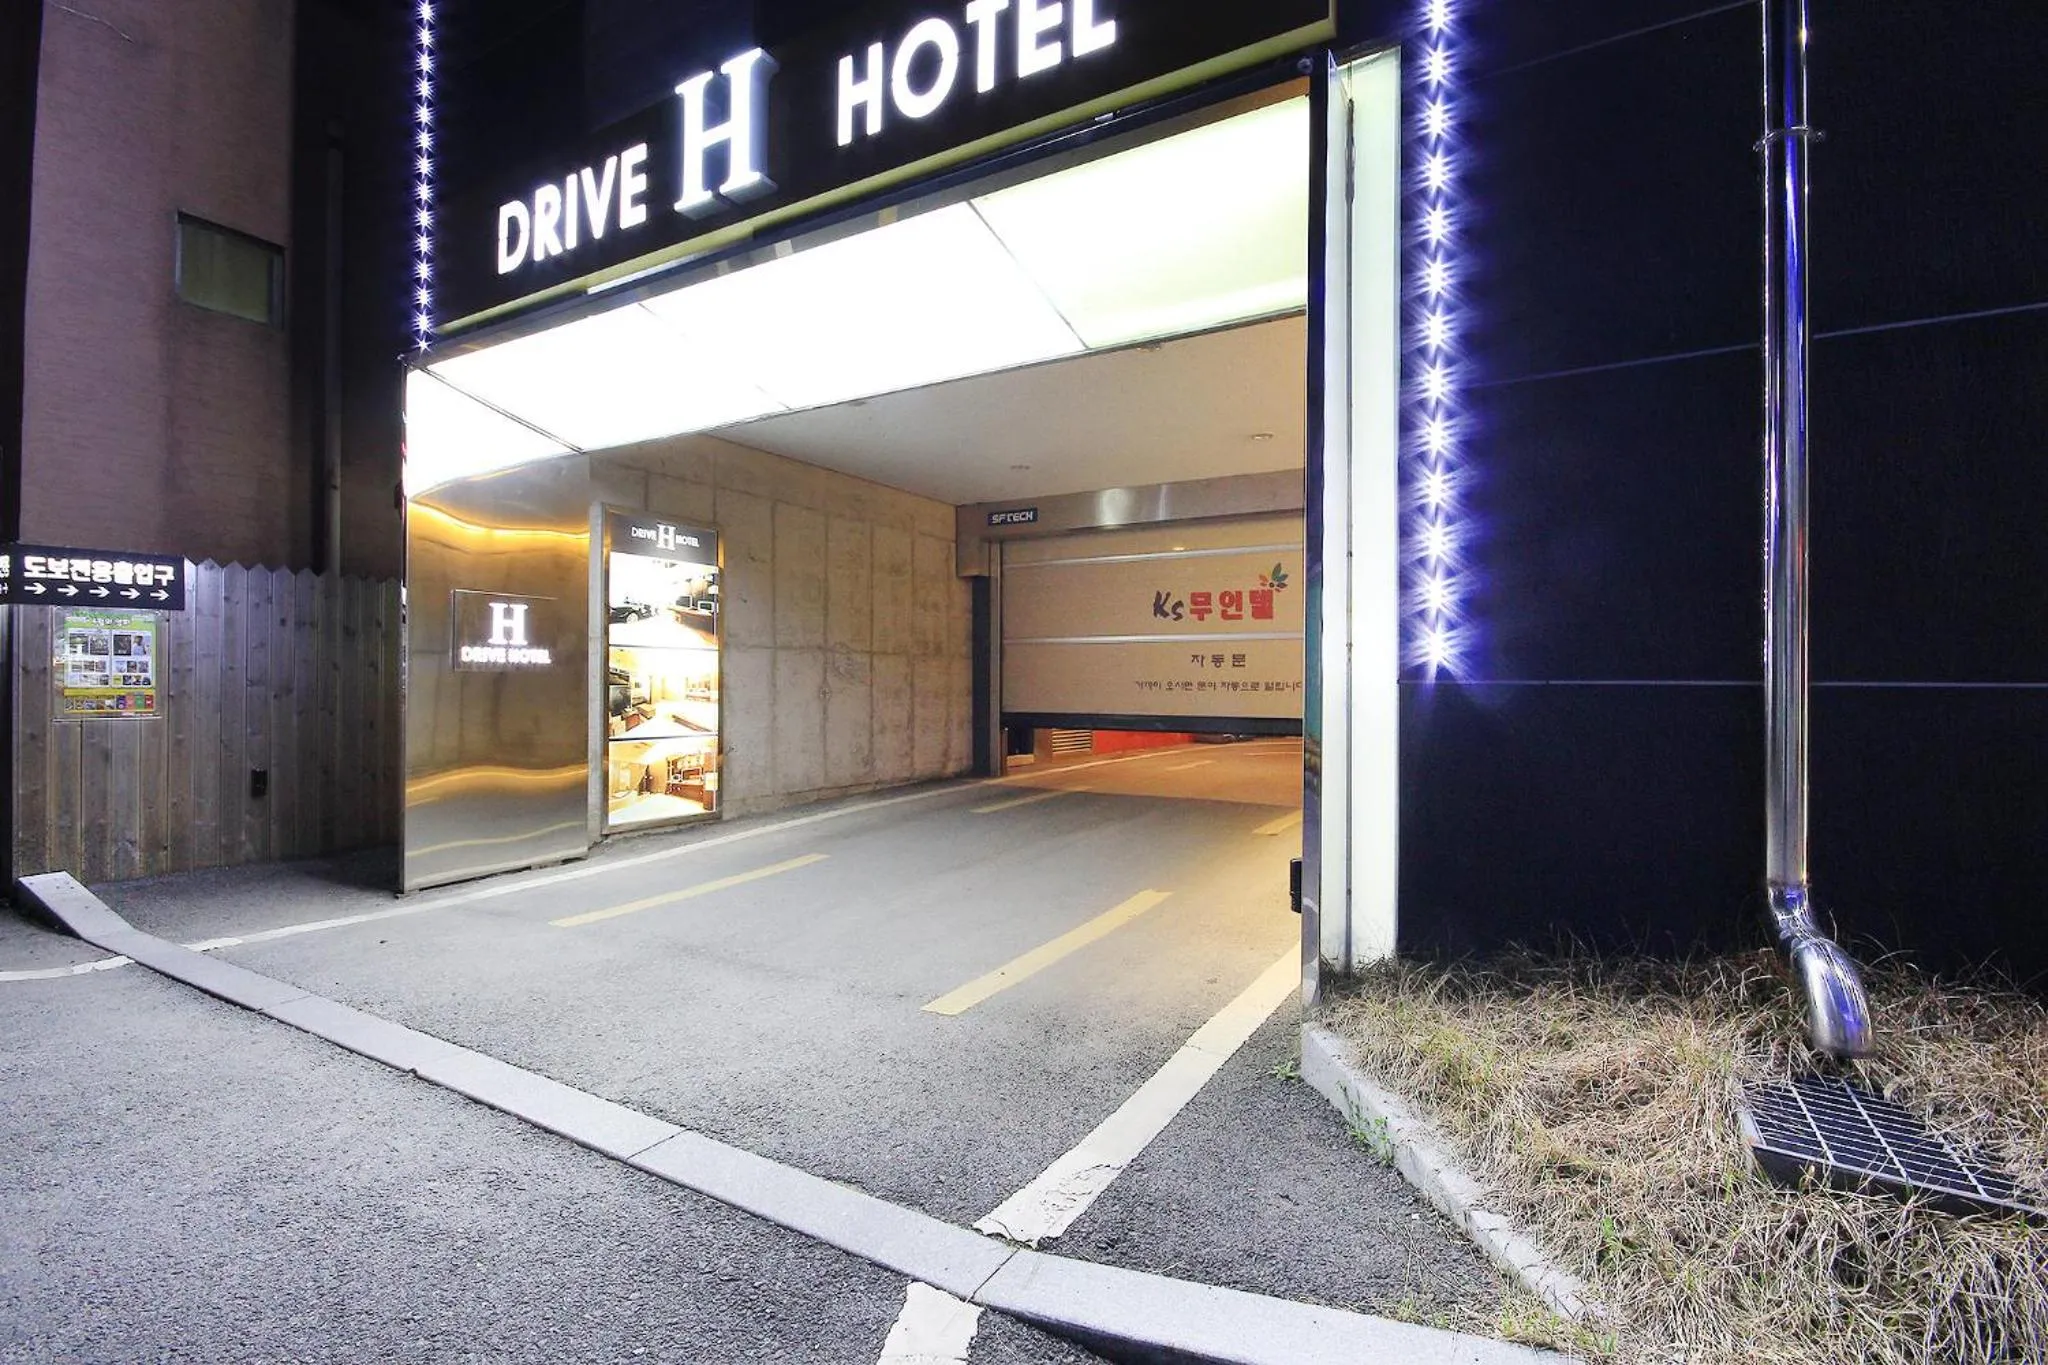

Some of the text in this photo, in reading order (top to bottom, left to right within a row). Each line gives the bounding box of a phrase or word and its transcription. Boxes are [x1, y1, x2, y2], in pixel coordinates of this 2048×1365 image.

[498, 0, 1118, 276] DRIVE H HOTEL
[631, 523, 700, 551] DRIVE H HOTEL
[488, 602, 528, 646] H
[461, 646, 552, 664] DRIVE HOTEL
